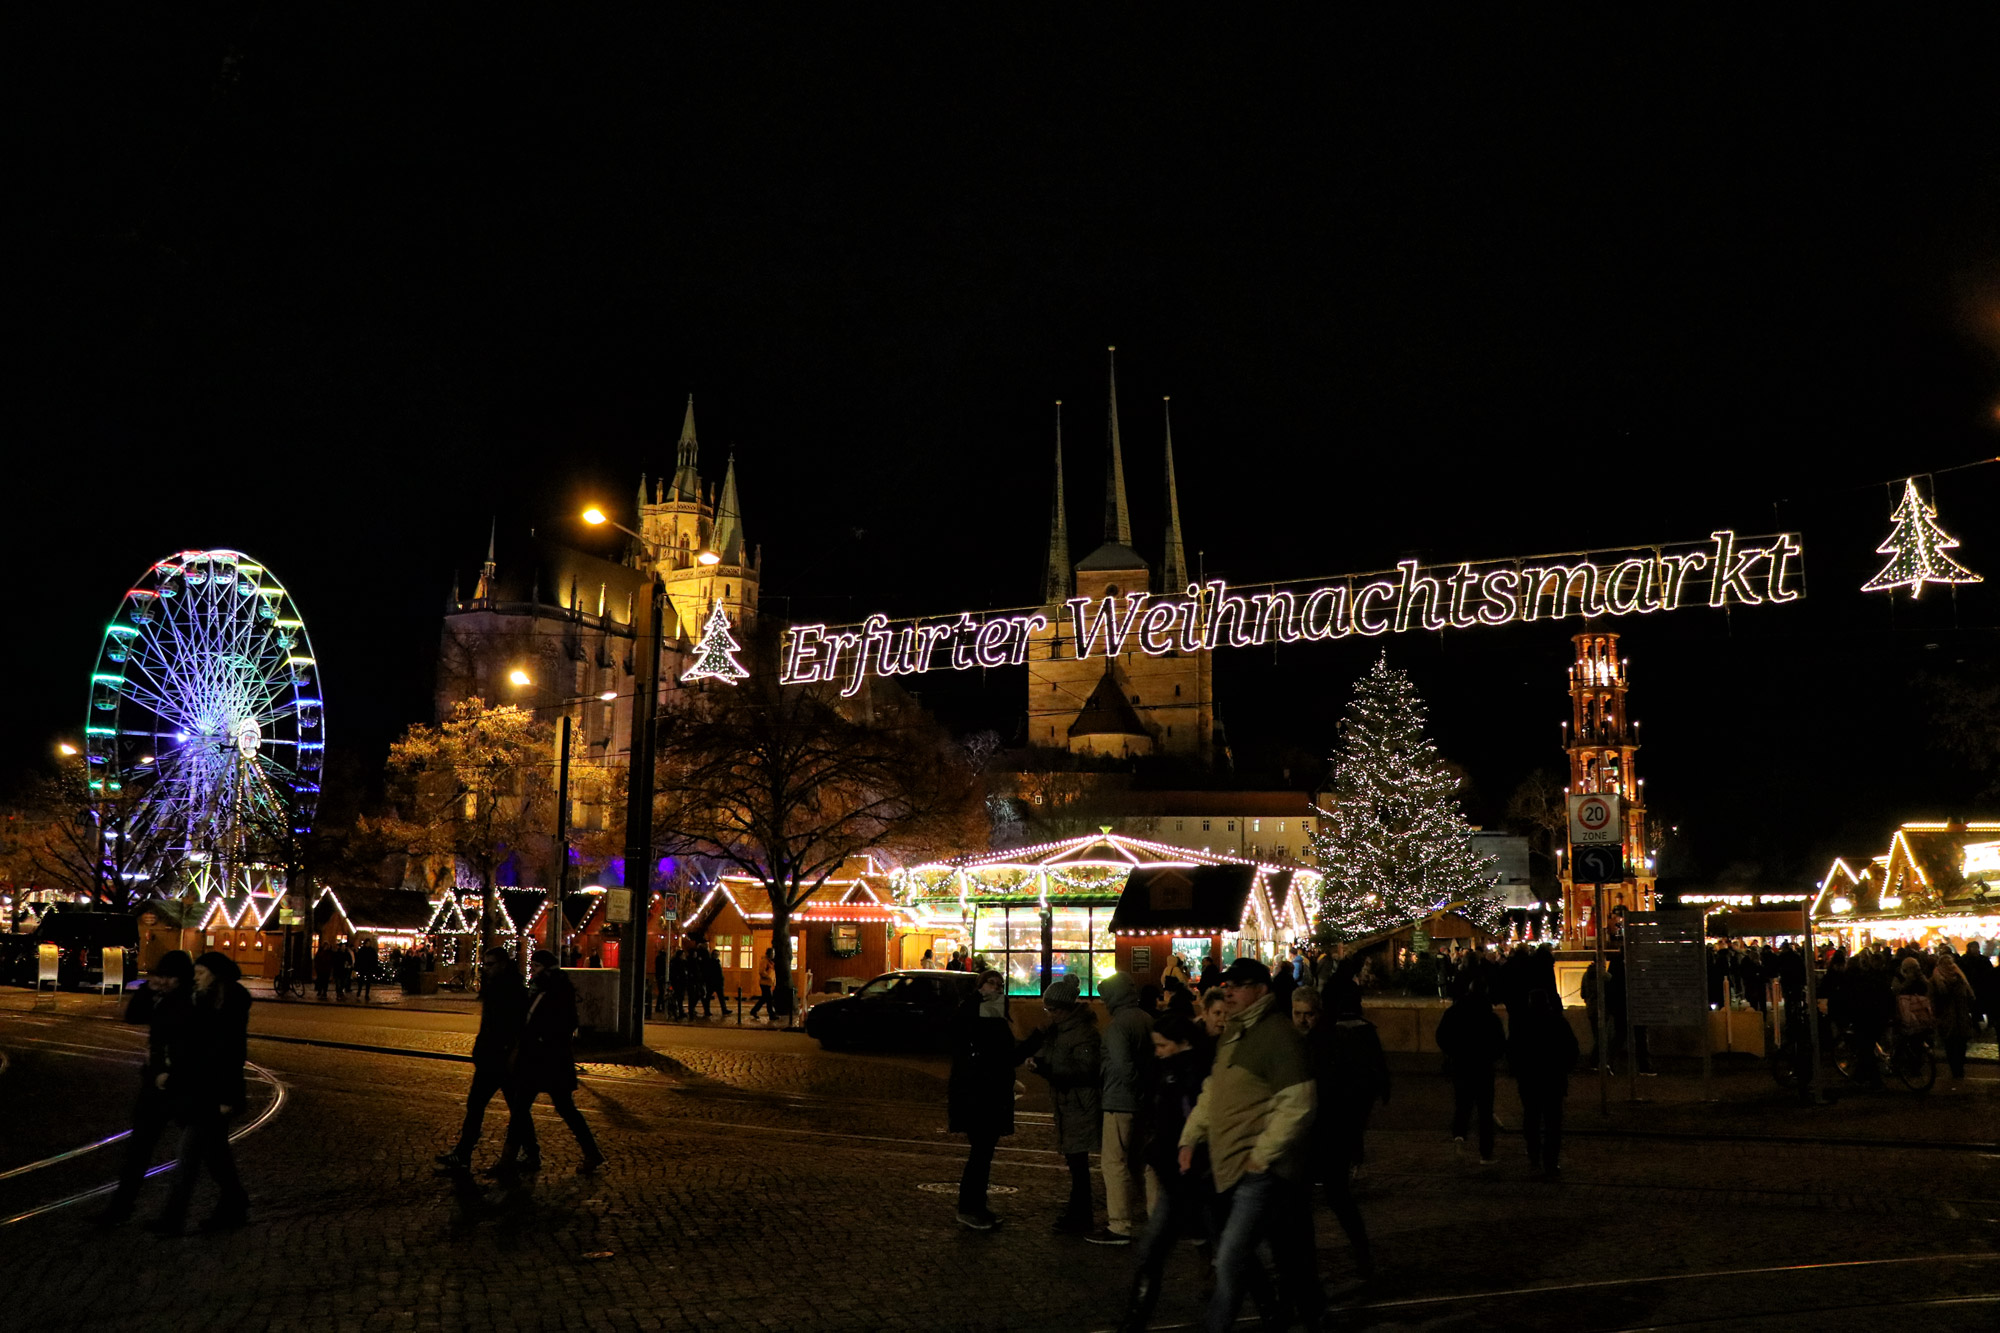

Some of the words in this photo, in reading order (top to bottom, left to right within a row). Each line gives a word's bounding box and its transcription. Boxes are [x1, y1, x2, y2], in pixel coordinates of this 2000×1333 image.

[780, 612, 1047, 698] Erfurter
[1066, 530, 1801, 661] Weihnachtsmarkt
[1585, 807, 1604, 821] 20
[1582, 832, 1607, 841] ZONE
